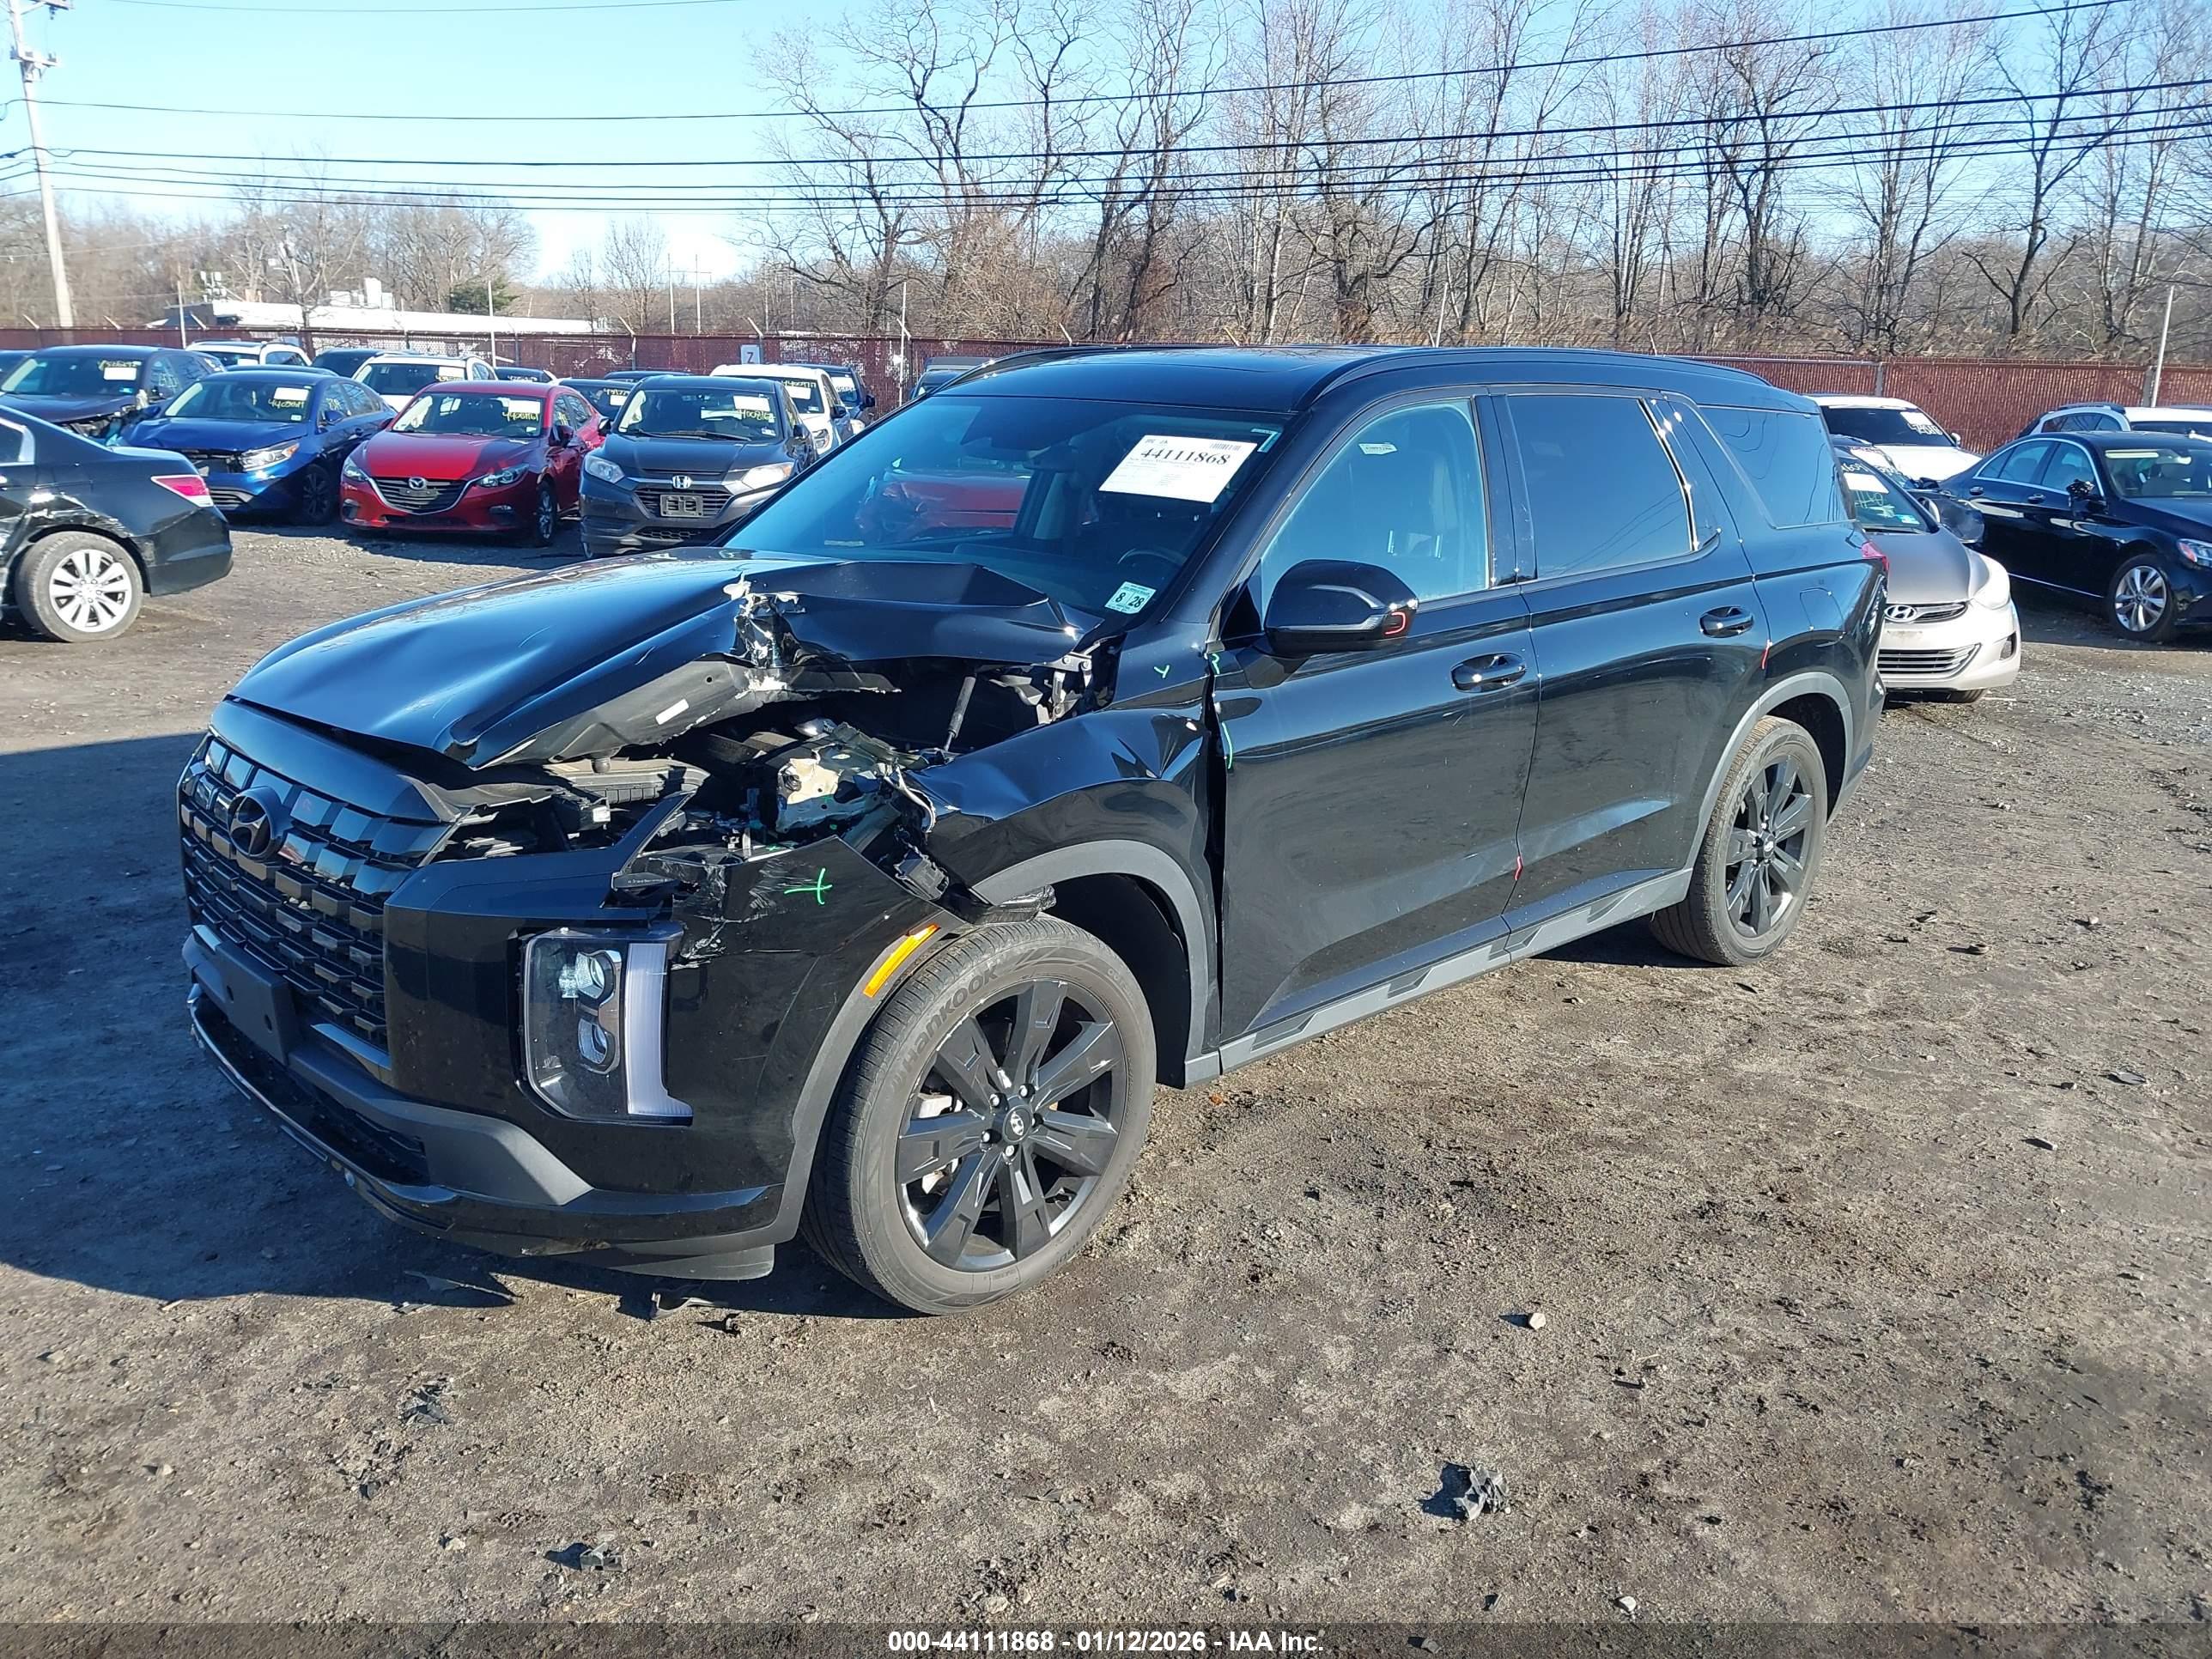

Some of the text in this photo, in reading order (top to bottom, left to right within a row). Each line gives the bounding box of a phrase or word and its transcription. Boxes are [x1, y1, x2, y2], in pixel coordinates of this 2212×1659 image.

[1140, 447, 1231, 465] 44111868
[1115, 592, 1127, 603] 8
[1127, 595, 1146, 608] 28
